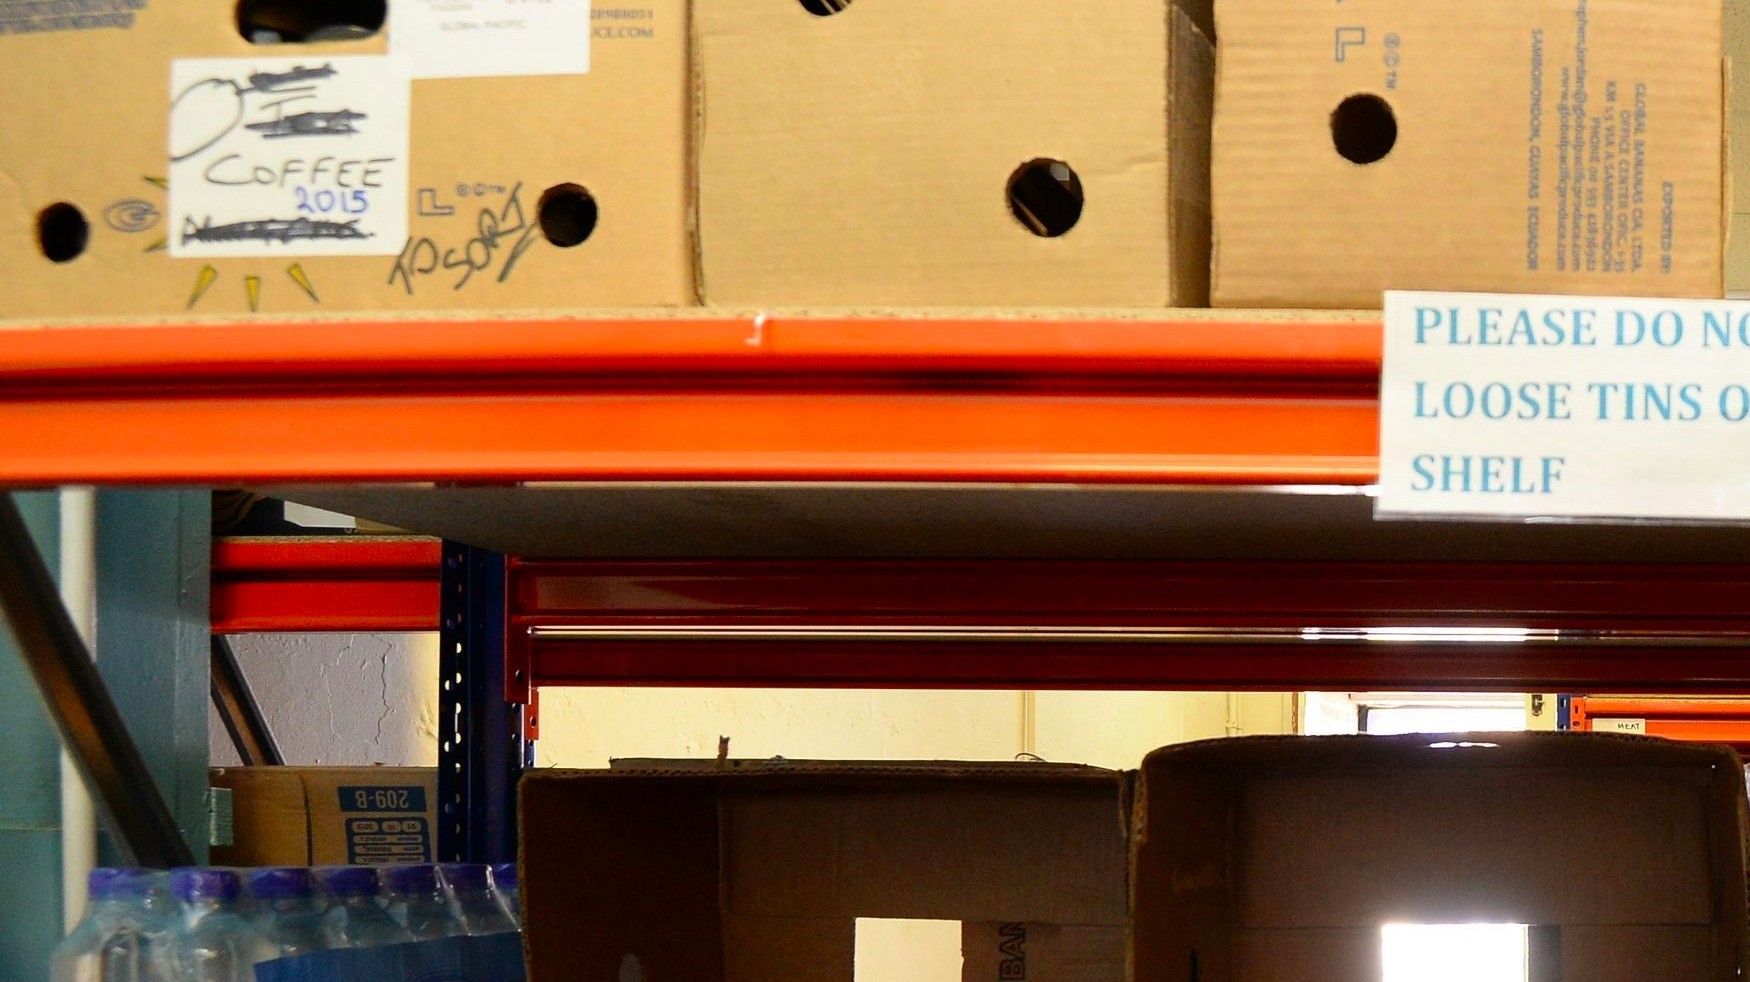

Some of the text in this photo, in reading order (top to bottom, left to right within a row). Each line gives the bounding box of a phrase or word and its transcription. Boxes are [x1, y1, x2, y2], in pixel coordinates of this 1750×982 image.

[1634, 83, 1646, 135] GLOBAL
[1589, 117, 1600, 163] PHONE
[1605, 126, 1614, 146] VIA
[205, 153, 396, 188] COFFEE
[1618, 159, 1629, 208] CENTER
[1633, 140, 1645, 203] BANANAS
[295, 186, 368, 214] 2015
[1602, 164, 1613, 272] SAMBORONDON
[1527, 206, 1540, 270] ECUADOR
[1414, 307, 1597, 346] PLEASE
[1615, 309, 1684, 347] DO
[1414, 381, 1573, 420] LOOSE
[1588, 383, 1701, 422] TINS
[1411, 454, 1565, 494] SHELF
[356, 791, 408, 808] 209-B
